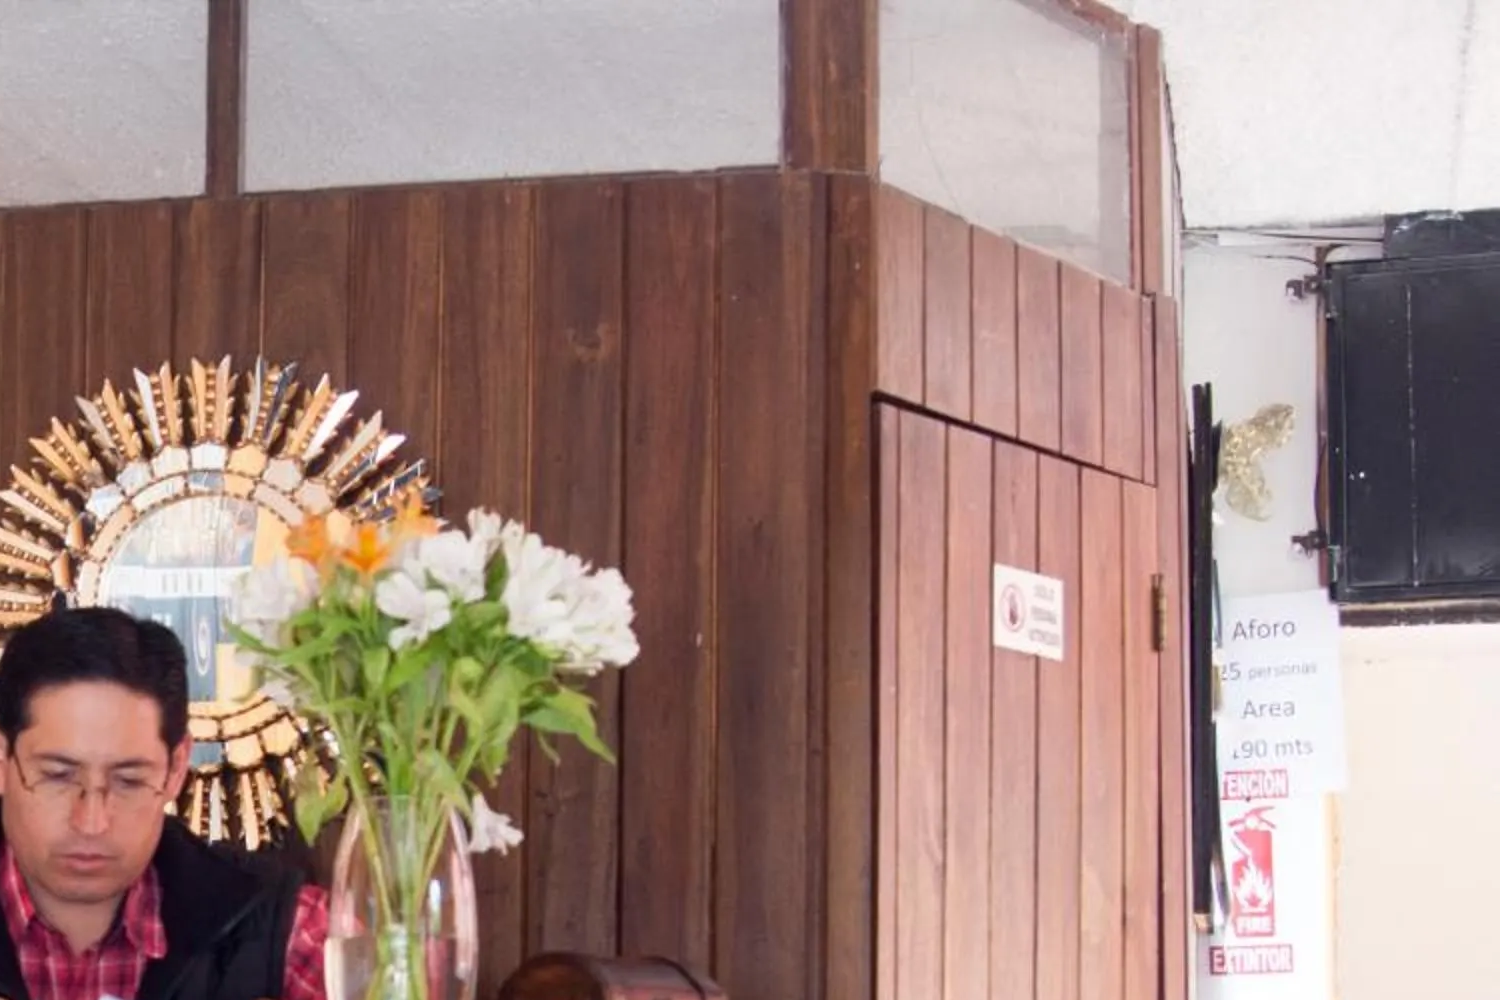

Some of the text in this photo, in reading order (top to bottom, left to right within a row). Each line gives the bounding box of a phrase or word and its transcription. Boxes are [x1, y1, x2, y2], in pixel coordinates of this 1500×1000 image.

[1232, 619, 1296, 641] Aforo
[1248, 661, 1318, 681] personas
[1242, 699, 1296, 720] Area
[1275, 738, 1314, 758] mts
